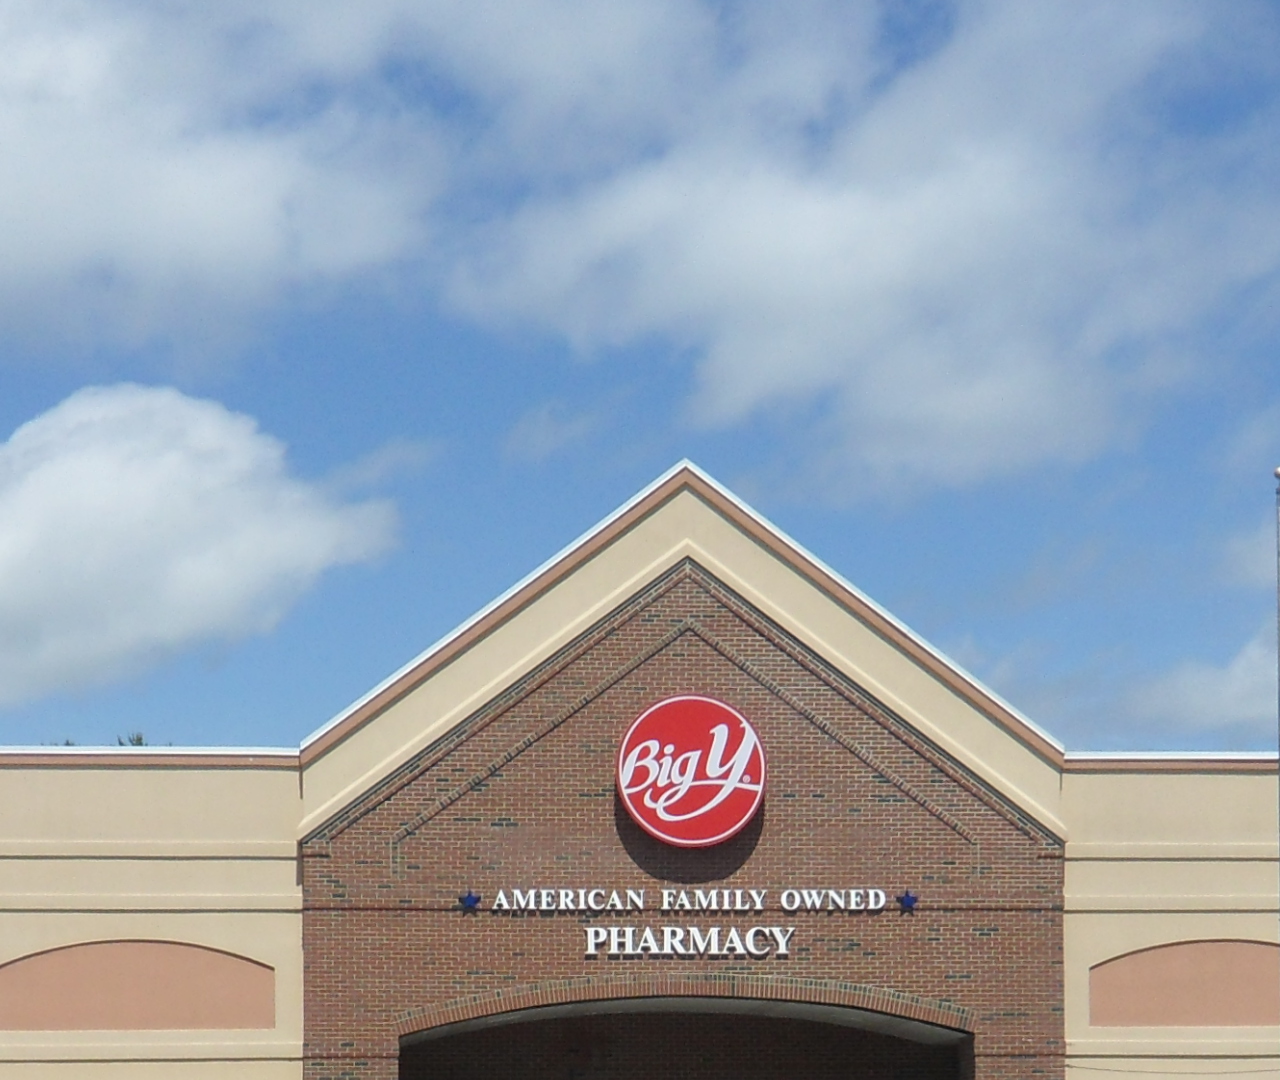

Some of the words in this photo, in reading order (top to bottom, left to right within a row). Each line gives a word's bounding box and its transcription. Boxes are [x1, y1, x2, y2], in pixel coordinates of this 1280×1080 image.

[621, 739, 702, 809] Big
[492, 889, 645, 911] AMERICAN
[661, 889, 768, 911] FAMILY
[780, 889, 887, 911] OWNED
[585, 926, 796, 956] PHARMACY
